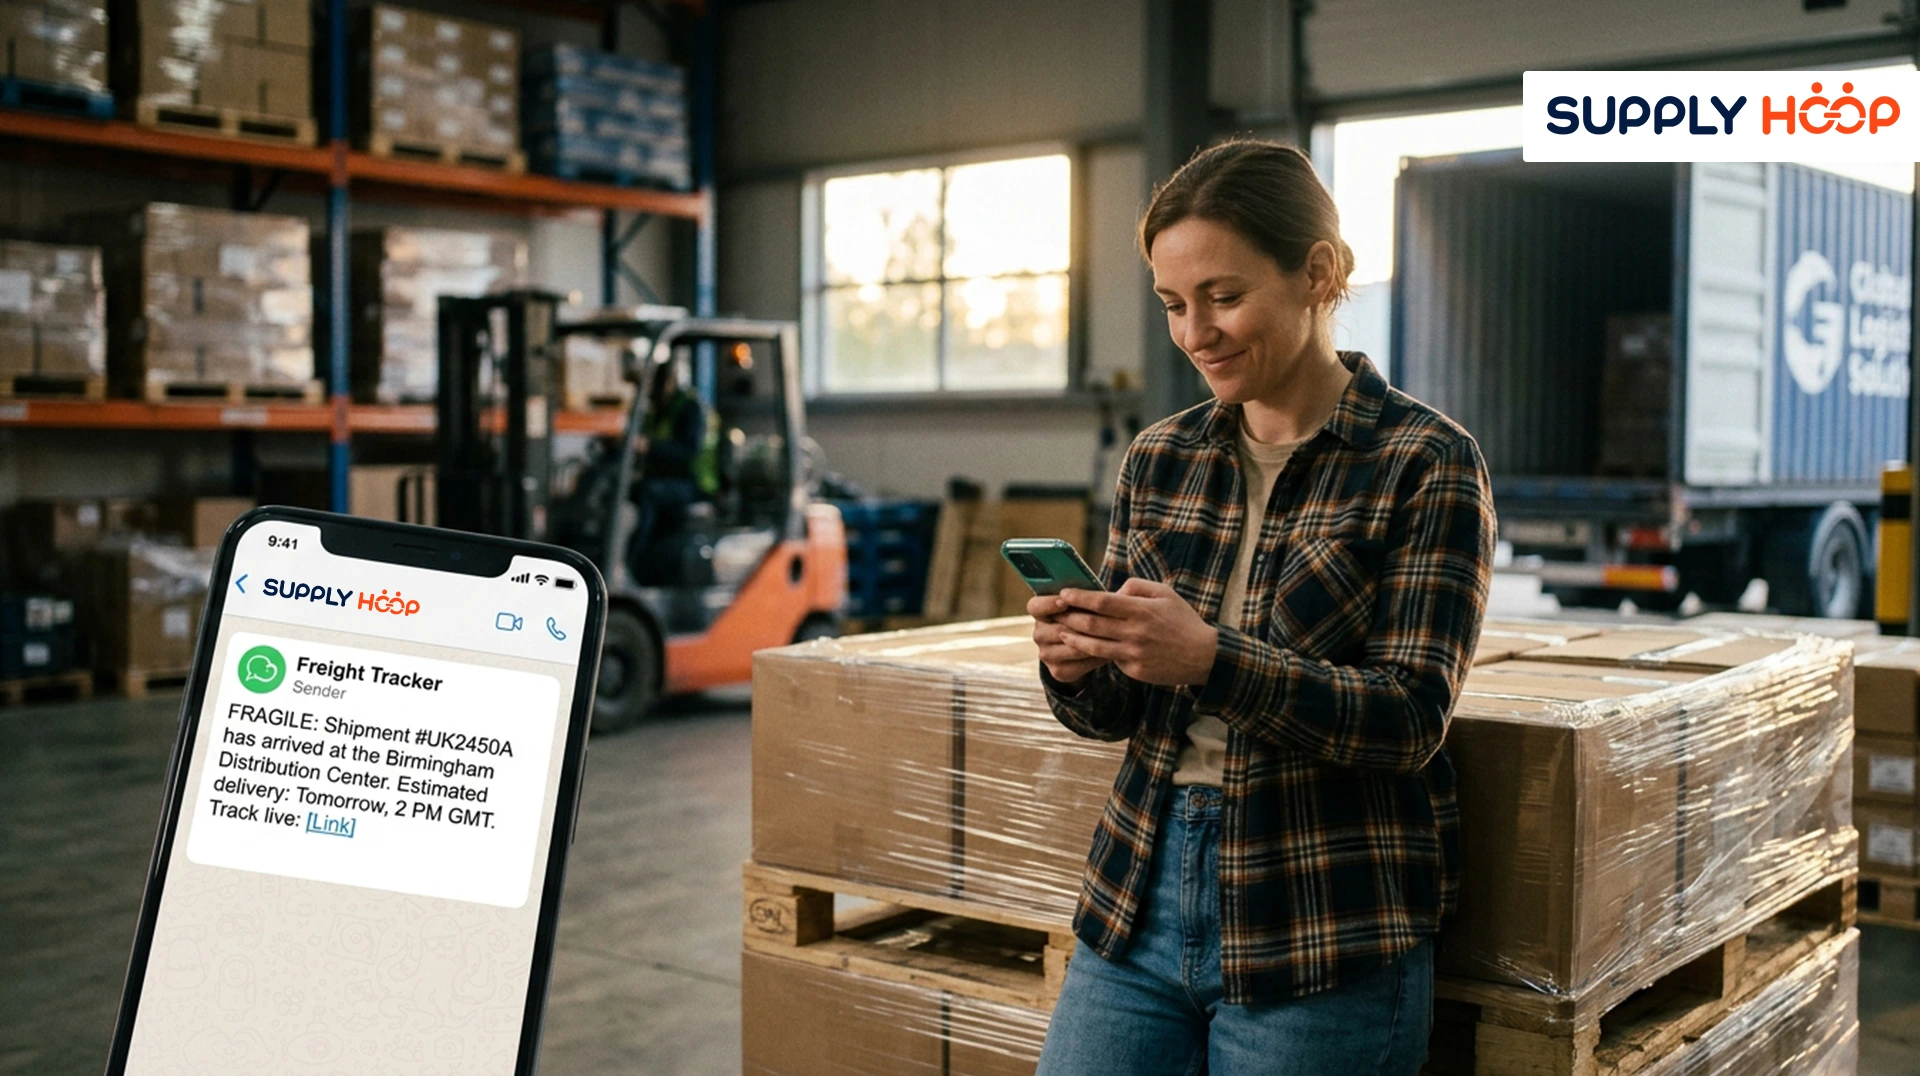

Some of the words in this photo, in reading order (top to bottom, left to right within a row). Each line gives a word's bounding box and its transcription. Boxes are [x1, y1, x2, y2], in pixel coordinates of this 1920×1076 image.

[267, 535, 298, 550] 9:41
[262, 577, 354, 607] SUPPLY
[292, 680, 347, 700] Sender
[296, 656, 366, 682] Freight
[371, 665, 444, 692] Tracker
[227, 702, 319, 732] FRAGILE:
[323, 715, 411, 744] Shipment
[414, 728, 514, 758] #UK2450A
[222, 726, 256, 747] has
[261, 735, 325, 757] arrived
[329, 743, 347, 760] at
[352, 745, 381, 764] the
[385, 749, 495, 780] Birmingham
[218, 750, 321, 781] Distribution
[326, 765, 391, 791] Center.
[396, 775, 489, 803] Estimated
[208, 798, 259, 822] Track
[264, 806, 302, 828] live:
[305, 811, 357, 838] [Link]
[213, 775, 291, 804] delivery:
[296, 786, 390, 818] Tomorrow,
[394, 799, 408, 817] 2
[411, 801, 443, 822] PM
[448, 807, 496, 830] GMT.
